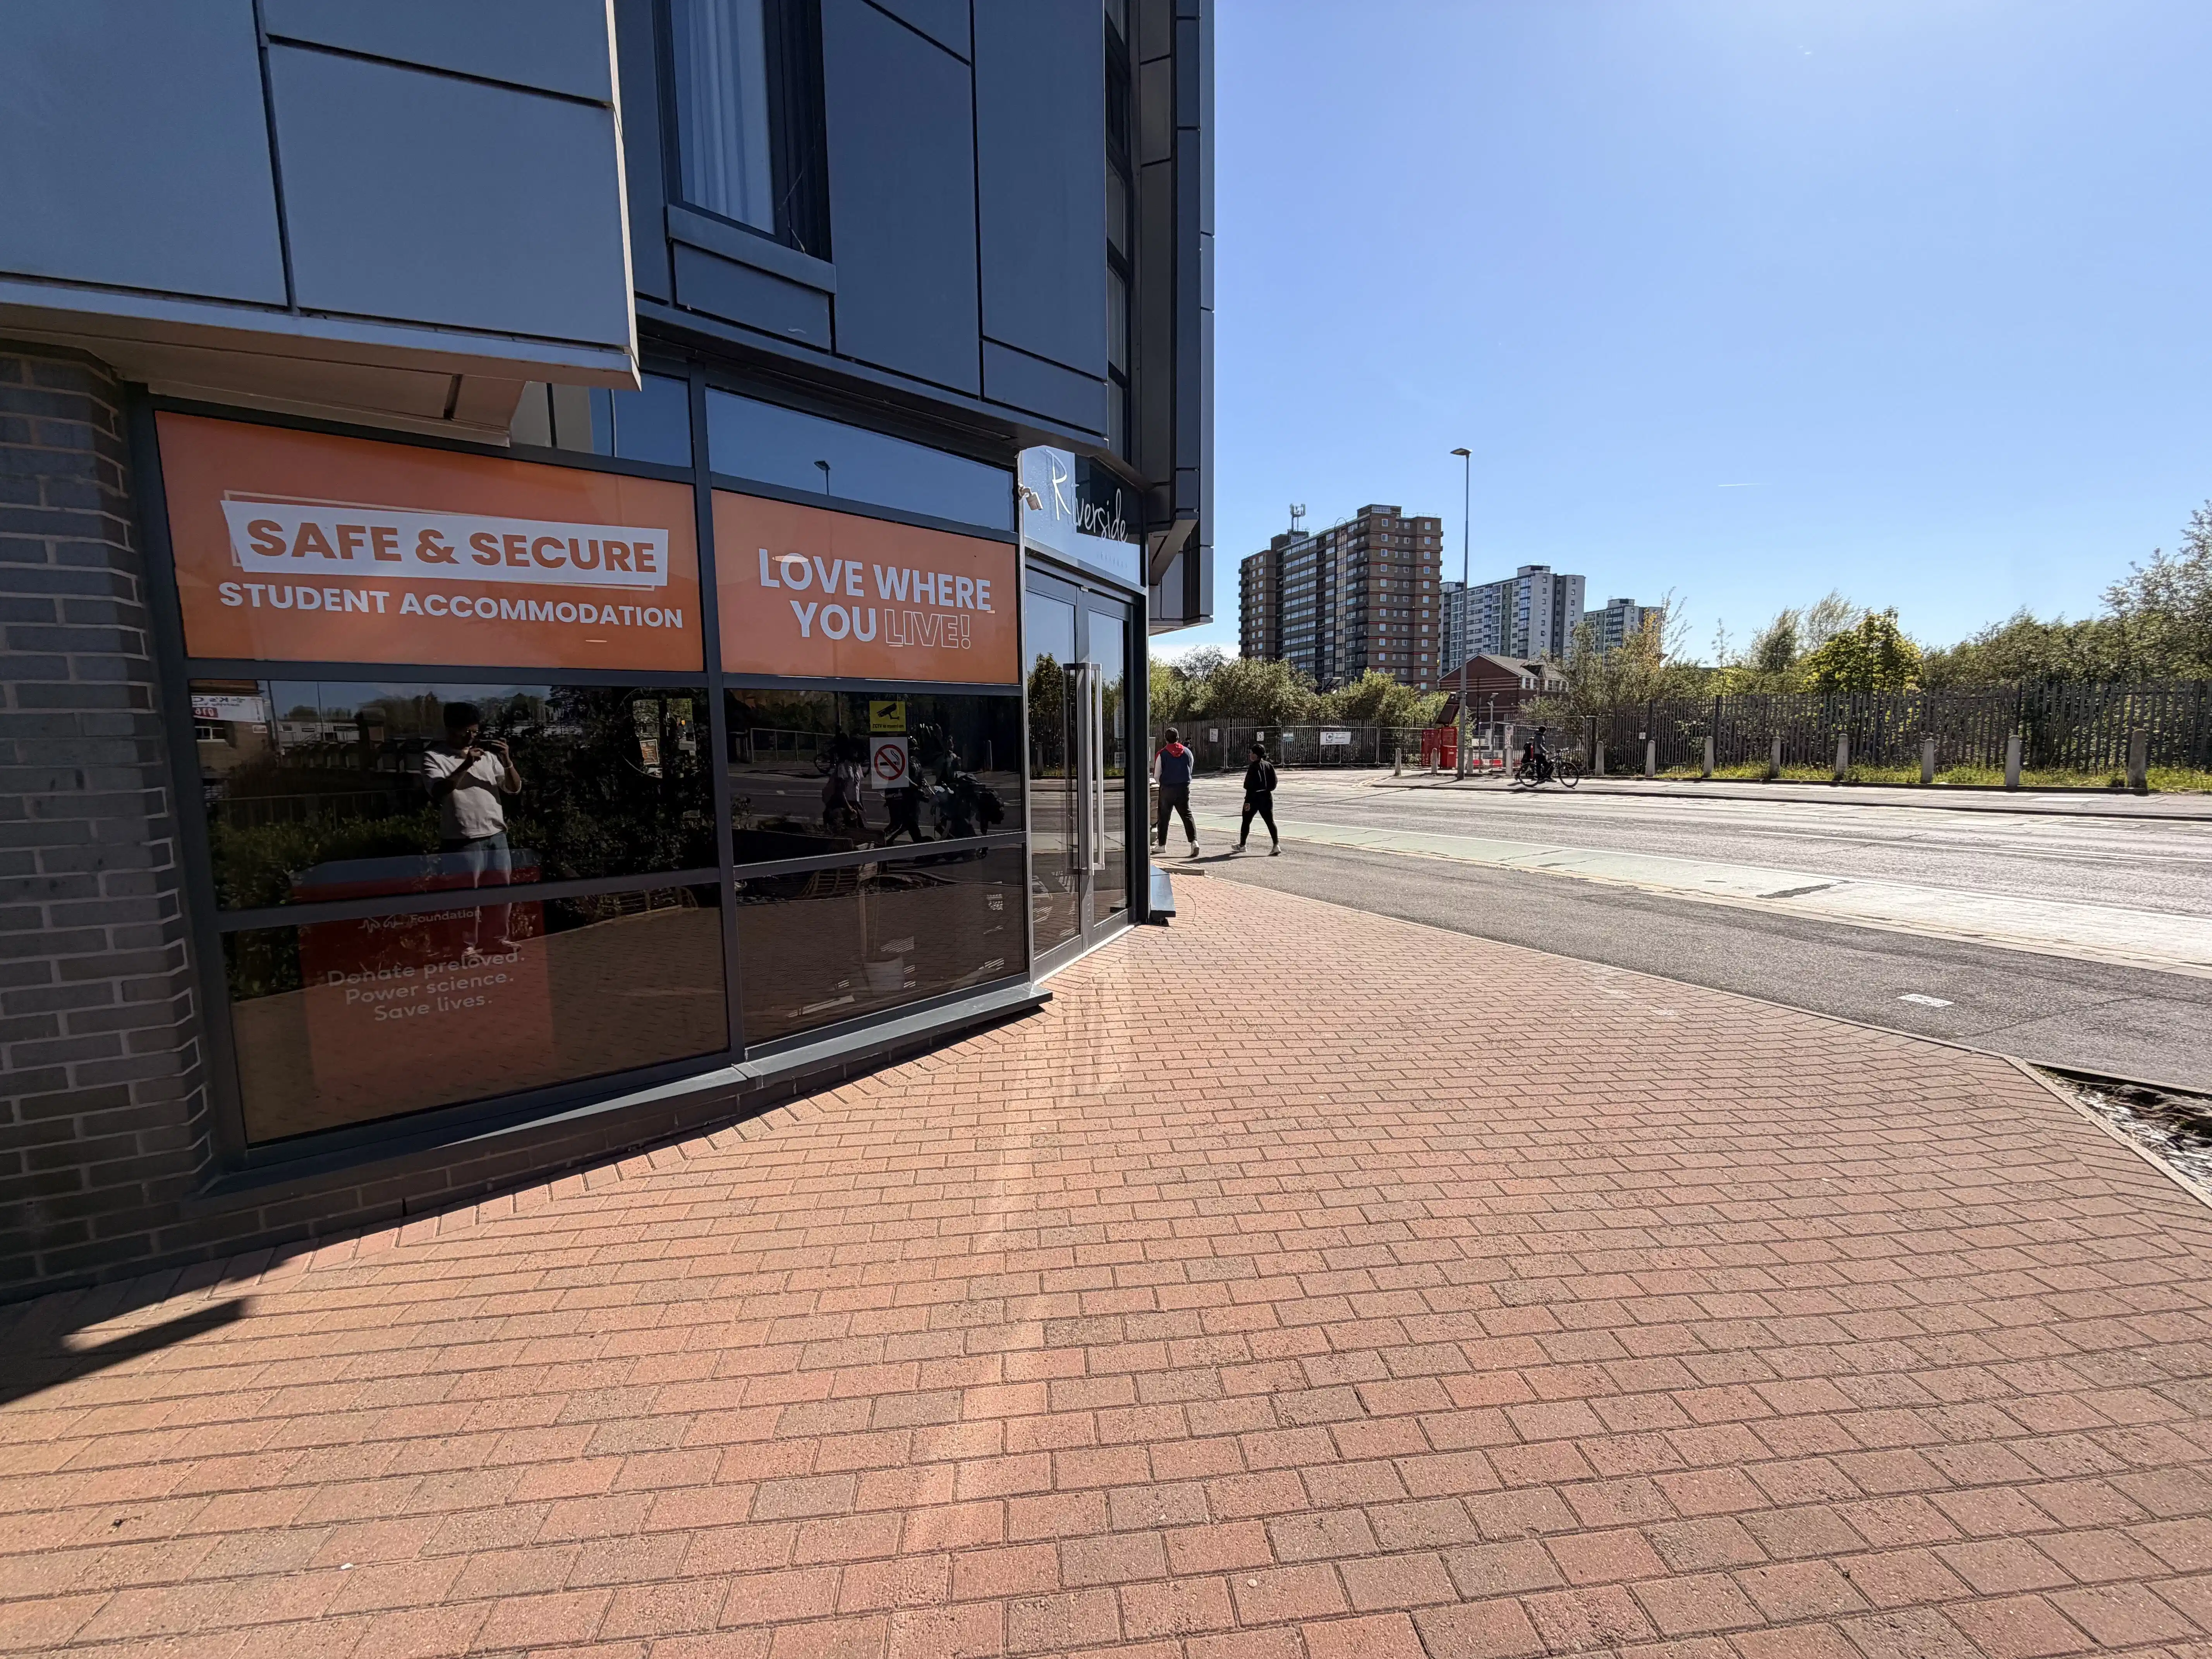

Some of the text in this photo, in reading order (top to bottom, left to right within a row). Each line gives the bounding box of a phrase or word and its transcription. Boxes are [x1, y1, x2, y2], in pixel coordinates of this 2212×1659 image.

[1045, 448, 1128, 545] Riverside
[247, 519, 657, 573] SAFE & SECURE
[758, 548, 992, 611] LOVE WHERE
[218, 582, 683, 629] STUDENT ACCOMMODATION
[789, 600, 971, 649] YOU LIVE!
[410, 909, 483, 924] Foundation
[327, 949, 526, 987] Donate preloved.
[345, 973, 514, 1005] Power science.
[374, 995, 493, 1022] Save lives.
